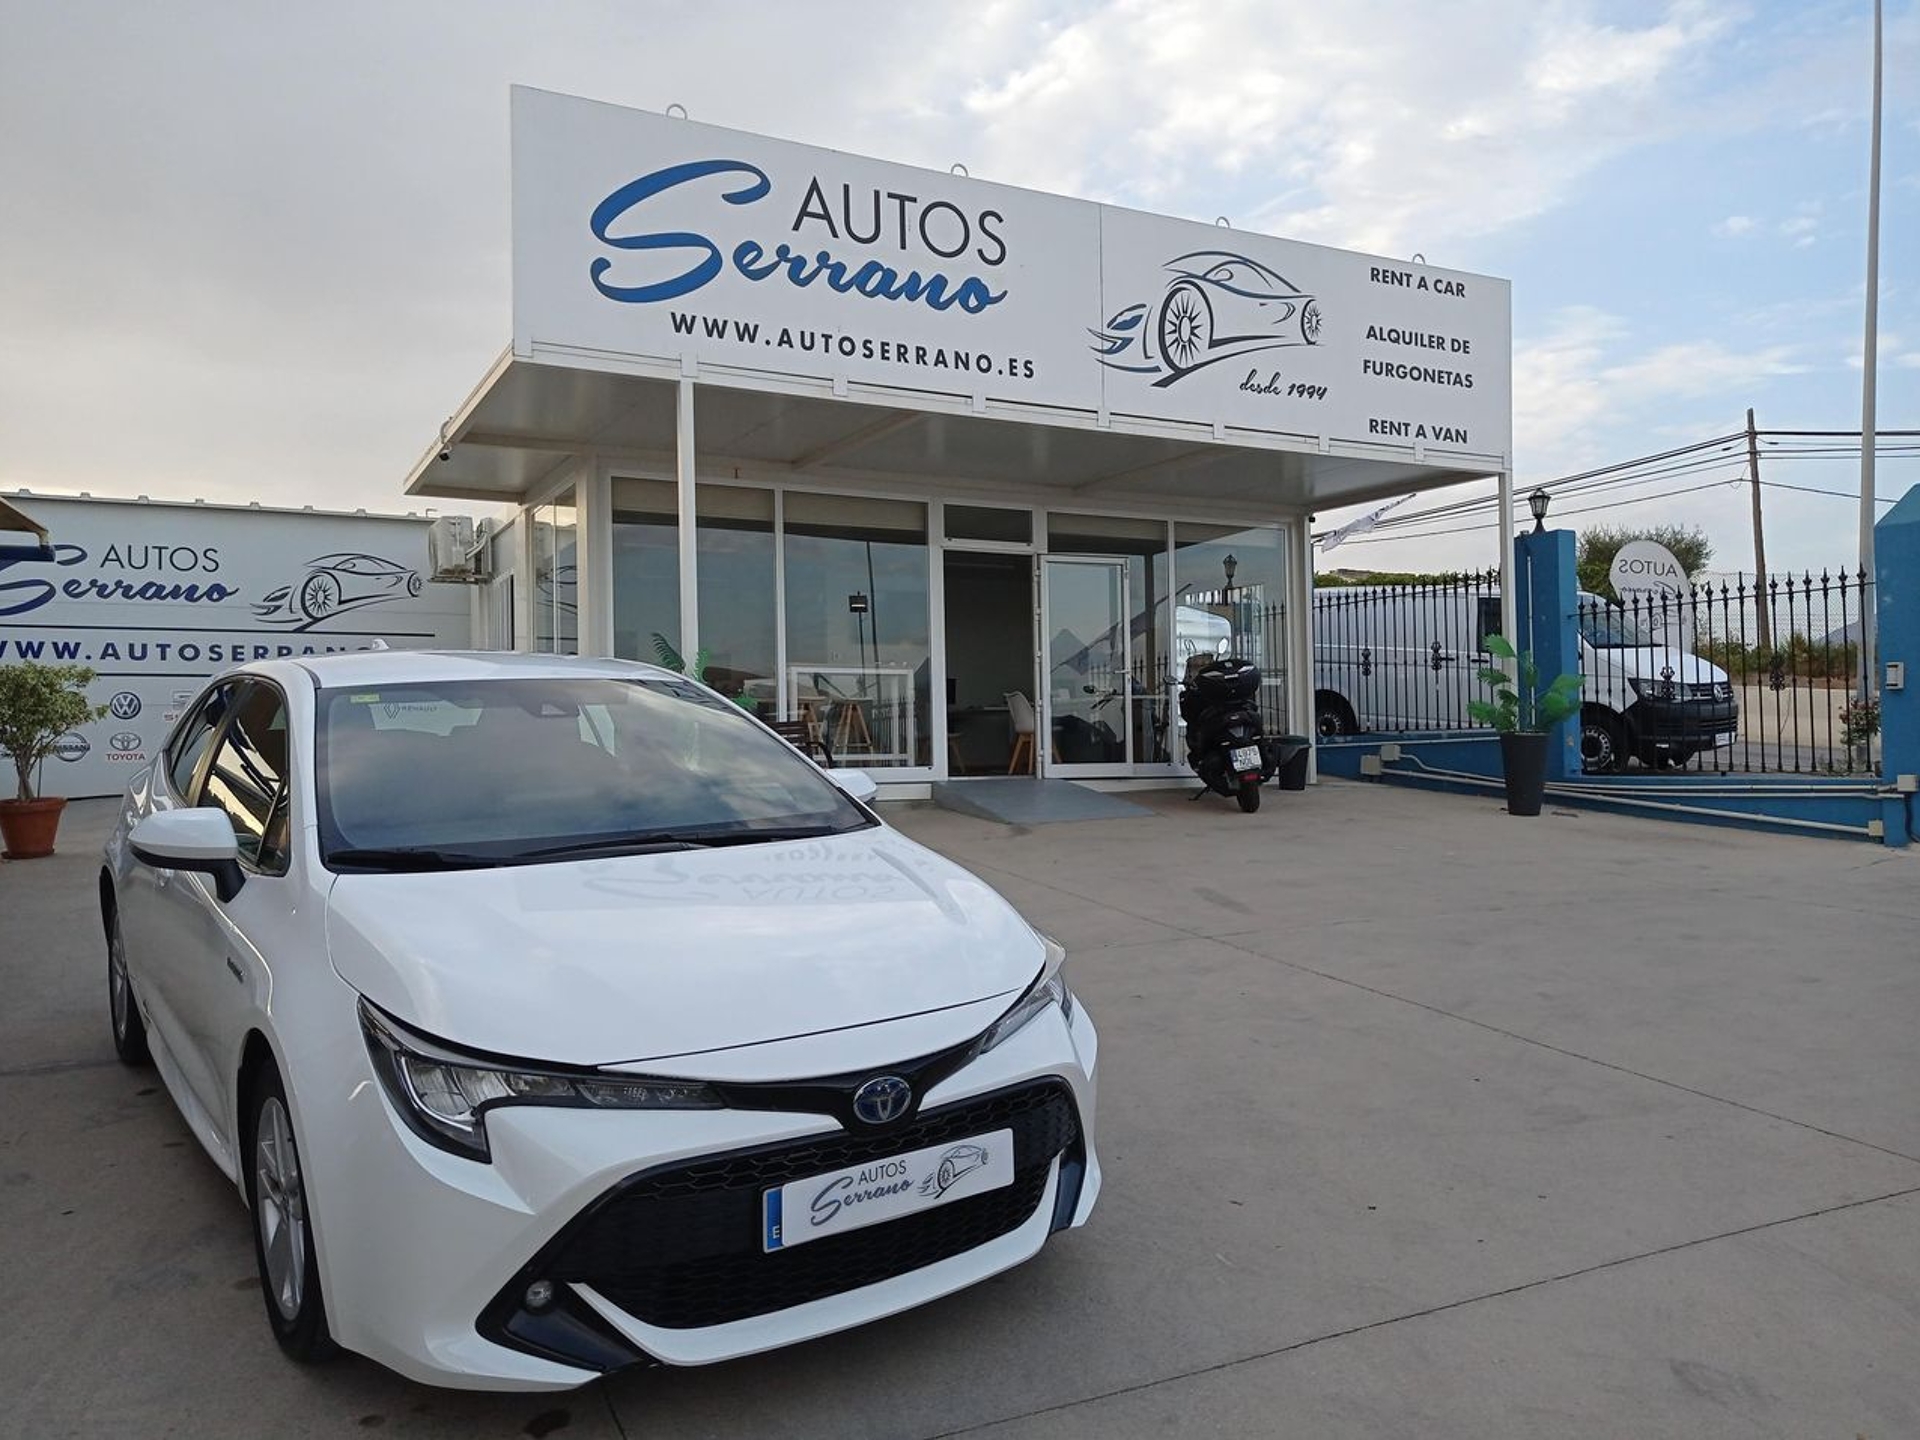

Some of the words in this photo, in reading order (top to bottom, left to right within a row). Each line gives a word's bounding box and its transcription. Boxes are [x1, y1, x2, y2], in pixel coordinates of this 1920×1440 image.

[590, 159, 1008, 314] Serrano
[791, 177, 1007, 266] AUTOS
[1370, 267, 1412, 288] RENT
[1417, 274, 1429, 291] A
[1433, 279, 1466, 298] CAR
[670, 311, 1035, 379] WWW.AUTOSERRANO.ES
[1366, 325, 1446, 352] ALQUILER
[1450, 336, 1470, 354] DE
[1239, 368, 1282, 396] desde
[1287, 383, 1328, 400] 1994
[1362, 359, 1474, 389] FURGONETAS
[1369, 418, 1411, 438] RENT
[1415, 424, 1427, 440] A
[1431, 426, 1468, 444] VAN
[100, 544, 219, 573] AUTOS
[106, 753, 146, 761] TOYOTA
[858, 1160, 907, 1186] AUTOS
[811, 1176, 915, 1226] Serrano
[772, 1227, 780, 1238] E
